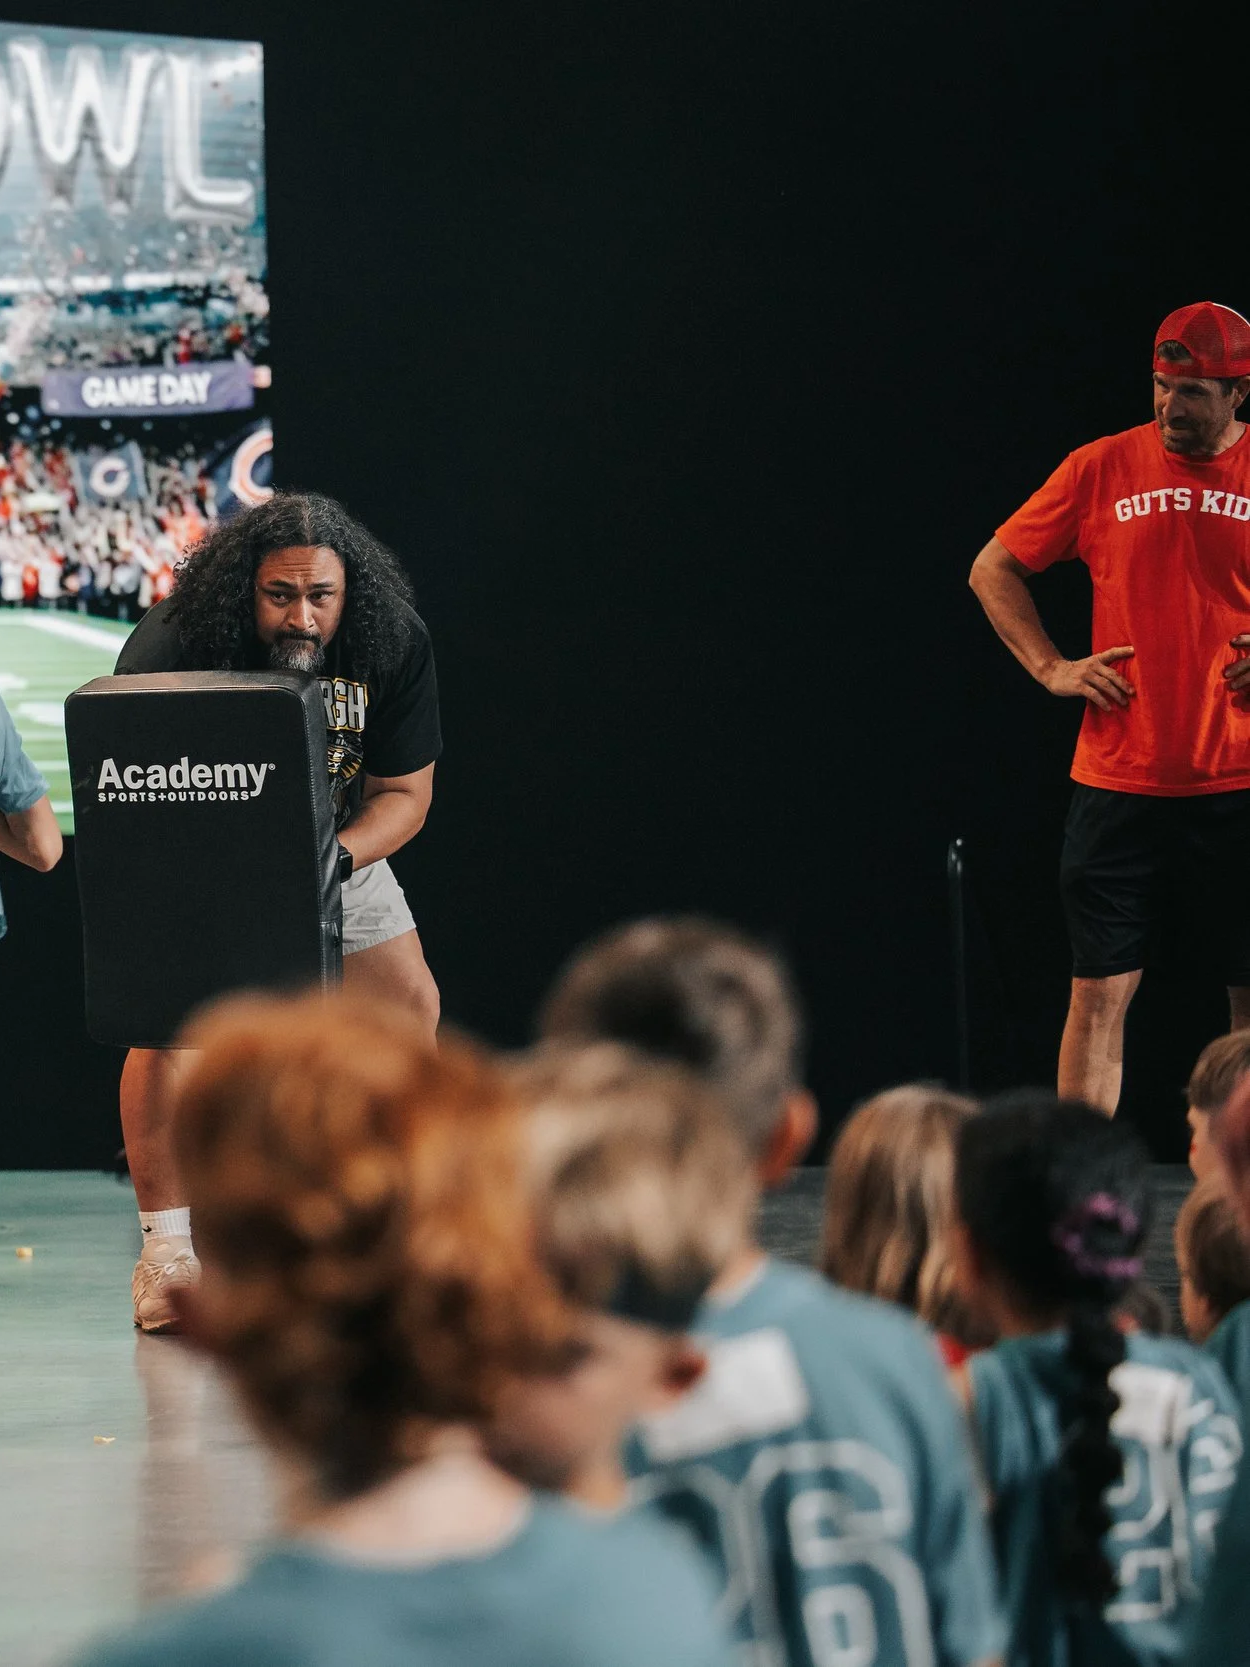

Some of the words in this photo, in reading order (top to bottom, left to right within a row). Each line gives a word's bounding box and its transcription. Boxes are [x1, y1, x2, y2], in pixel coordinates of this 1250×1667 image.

[81, 373, 158, 408] GAME
[158, 370, 212, 405] DAY
[1115, 487, 1192, 522] GUTS
[1200, 489, 1250, 522] KID
[98, 790, 250, 802] SPORTS+OUTDOORS
